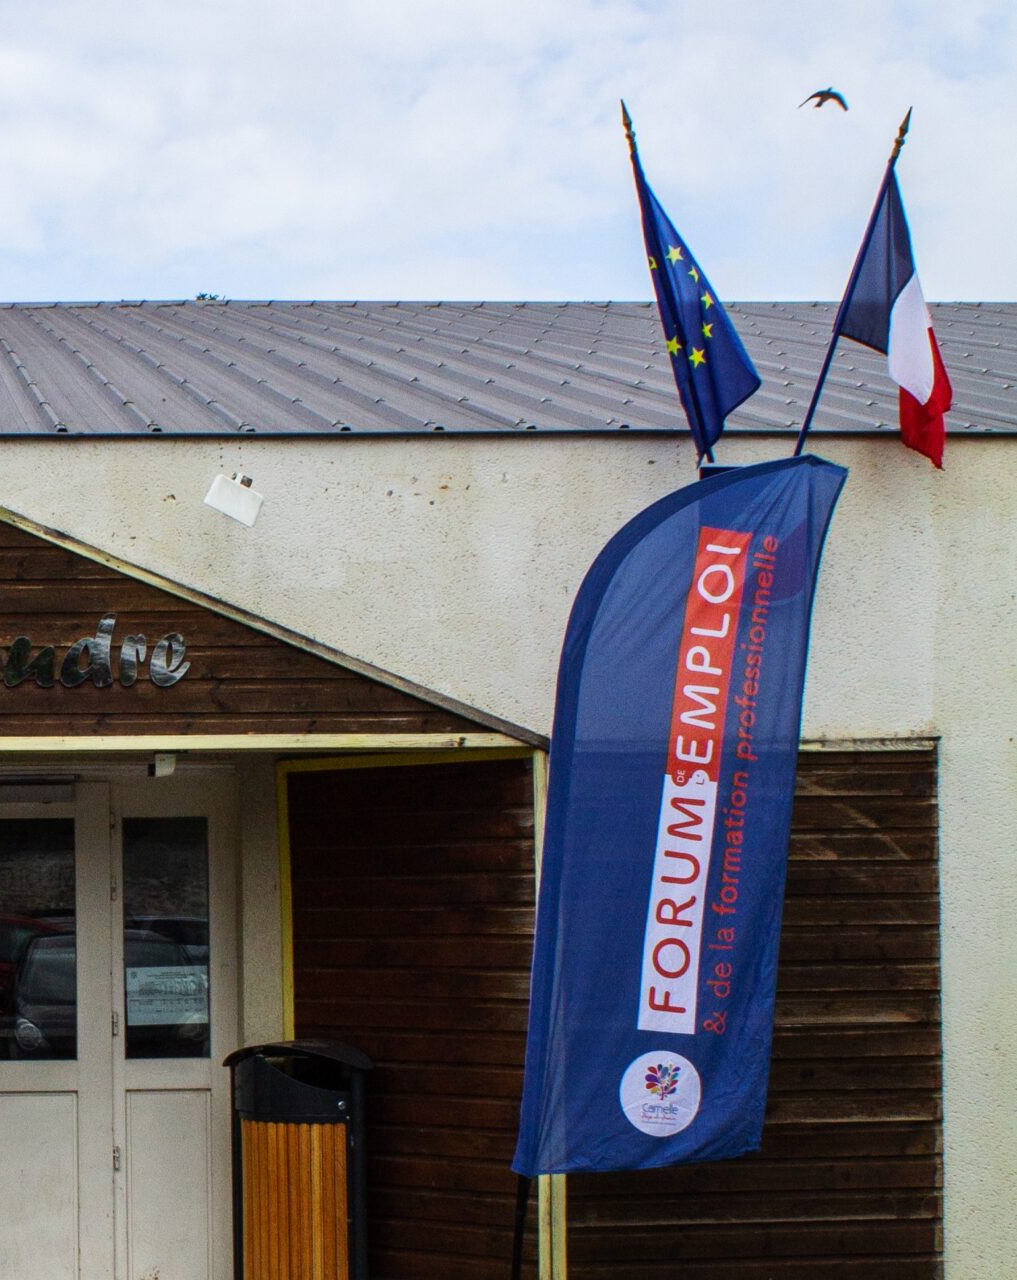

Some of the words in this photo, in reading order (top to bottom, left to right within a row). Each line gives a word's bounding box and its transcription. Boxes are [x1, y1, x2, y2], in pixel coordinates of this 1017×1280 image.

[675, 543, 742, 765] EMPLOI
[733, 535, 779, 762] professionnelle
[648, 796, 707, 1014] FORUM
[711, 771, 749, 916] formation
[706, 961, 733, 998] de
[708, 927, 735, 950] la
[703, 1010, 729, 1035] &
